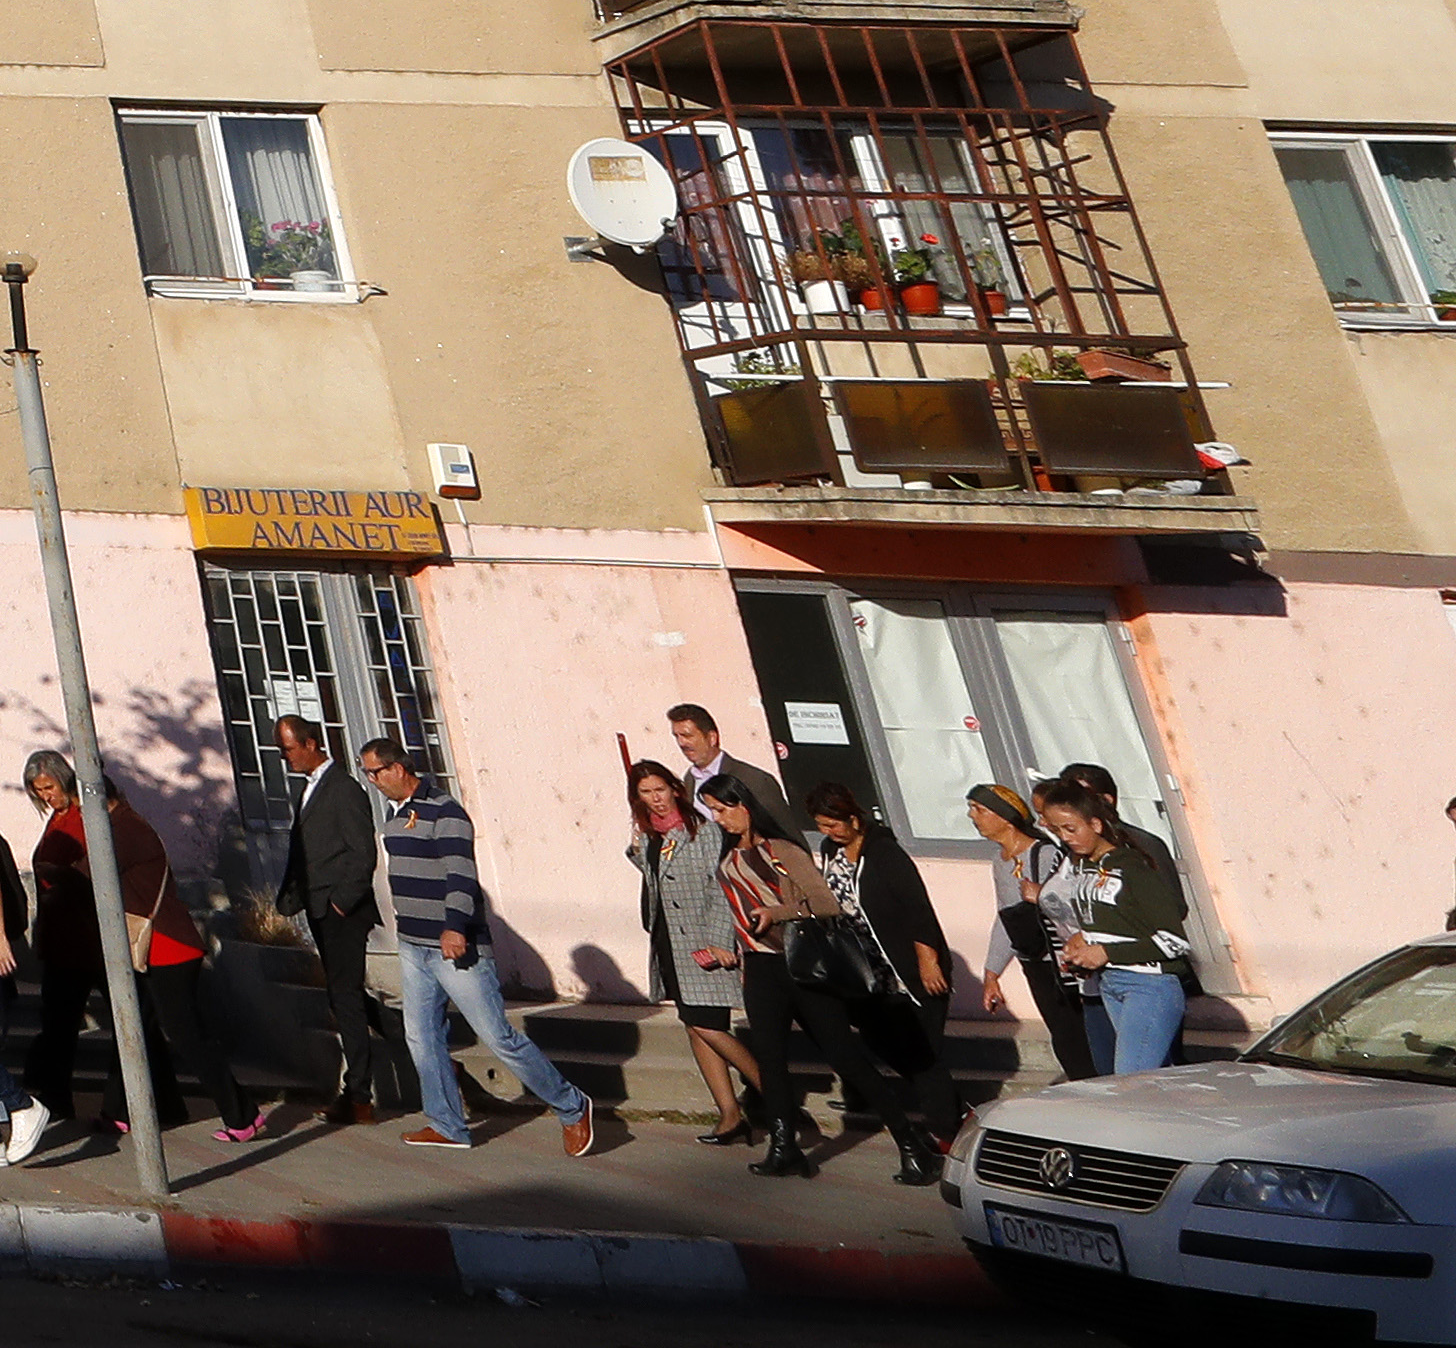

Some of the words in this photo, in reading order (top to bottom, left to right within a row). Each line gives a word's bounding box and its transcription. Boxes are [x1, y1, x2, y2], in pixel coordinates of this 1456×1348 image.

[202, 488, 352, 518] BIJUTERII
[365, 490, 430, 520] AUR
[250, 521, 402, 551] AMANET
